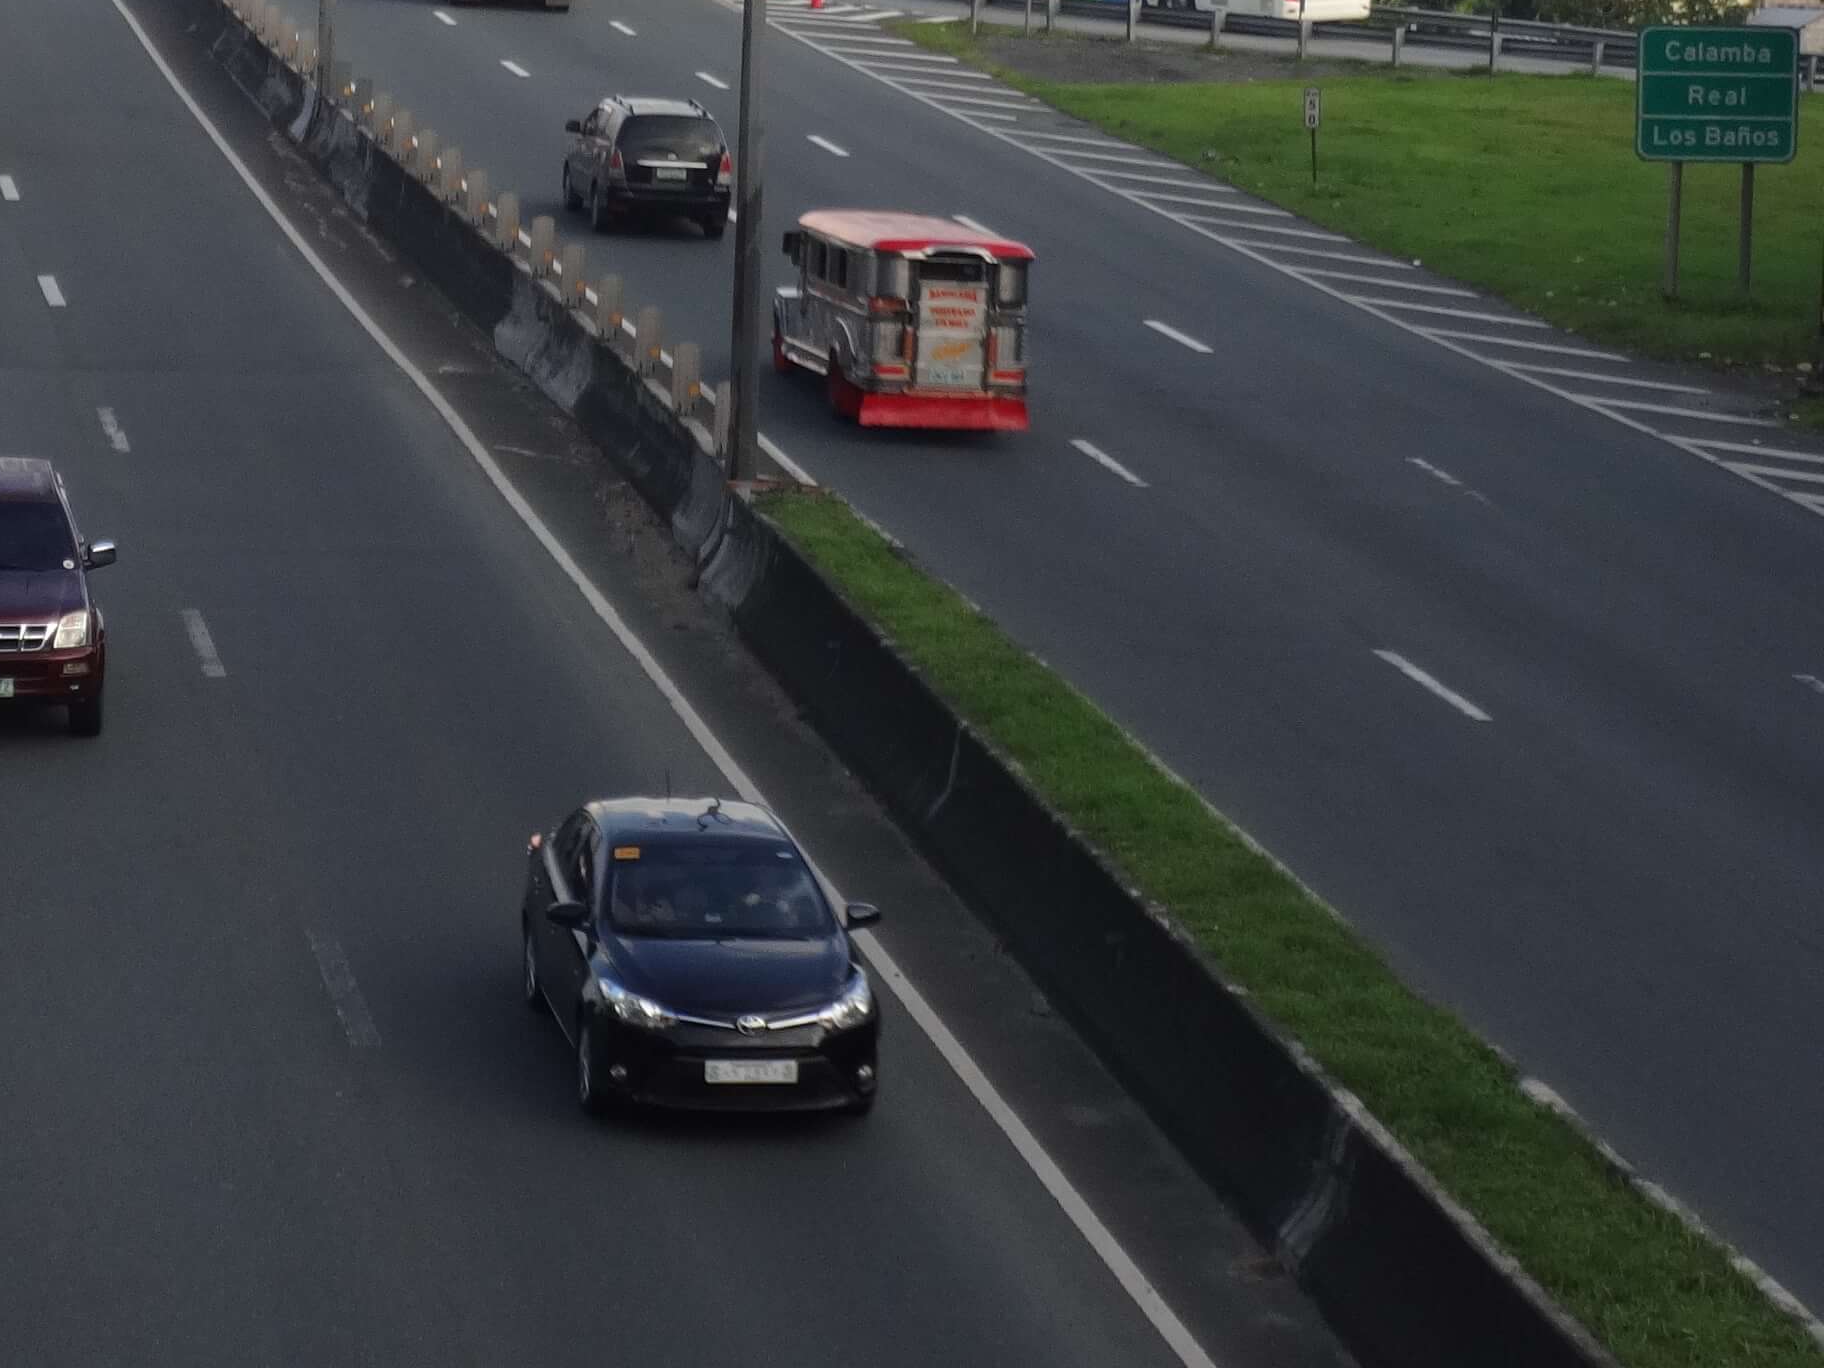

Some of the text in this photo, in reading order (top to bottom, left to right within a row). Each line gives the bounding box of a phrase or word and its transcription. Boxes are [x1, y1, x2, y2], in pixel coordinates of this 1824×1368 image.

[1665, 39, 1771, 64] Calamba
[1688, 85, 1746, 106] Real
[1653, 125, 1778, 146] Los Baños
